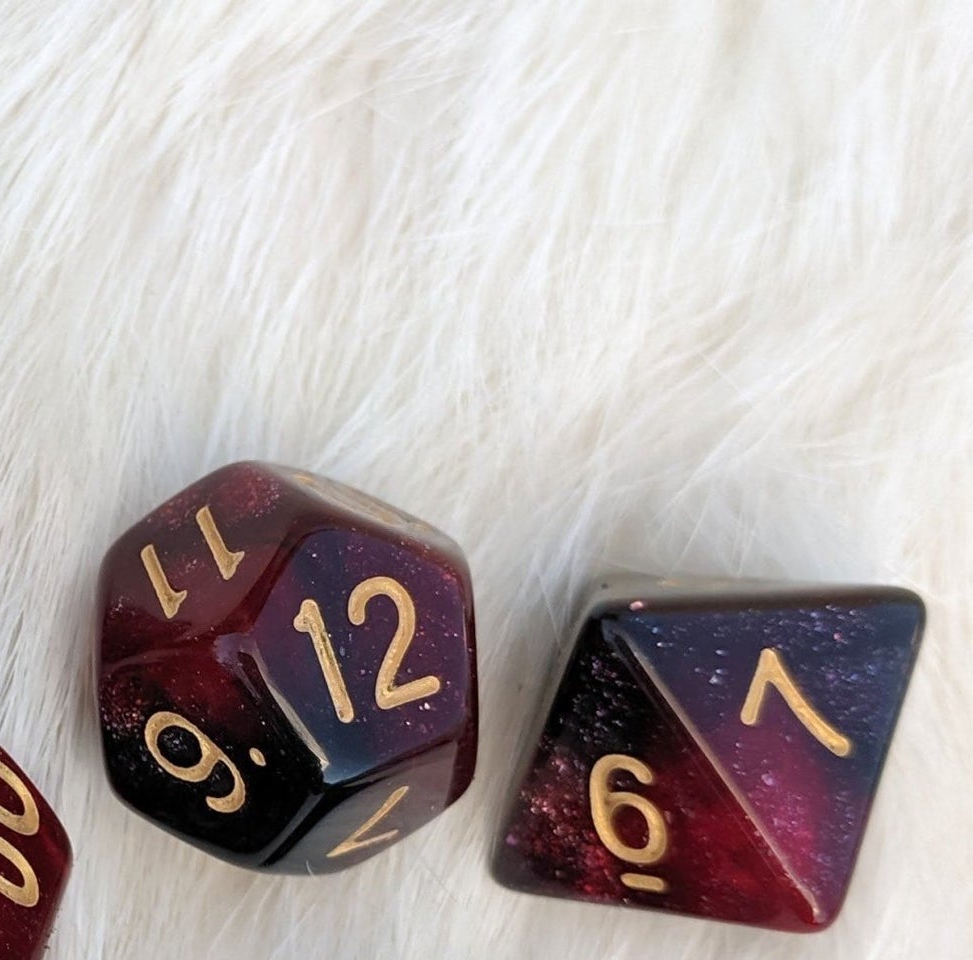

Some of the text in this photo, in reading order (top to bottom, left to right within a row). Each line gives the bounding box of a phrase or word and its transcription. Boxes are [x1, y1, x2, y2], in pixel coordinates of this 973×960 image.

[140, 505, 245, 619] 11
[292, 575, 441, 723] 12
[740, 648, 851, 757] 7
